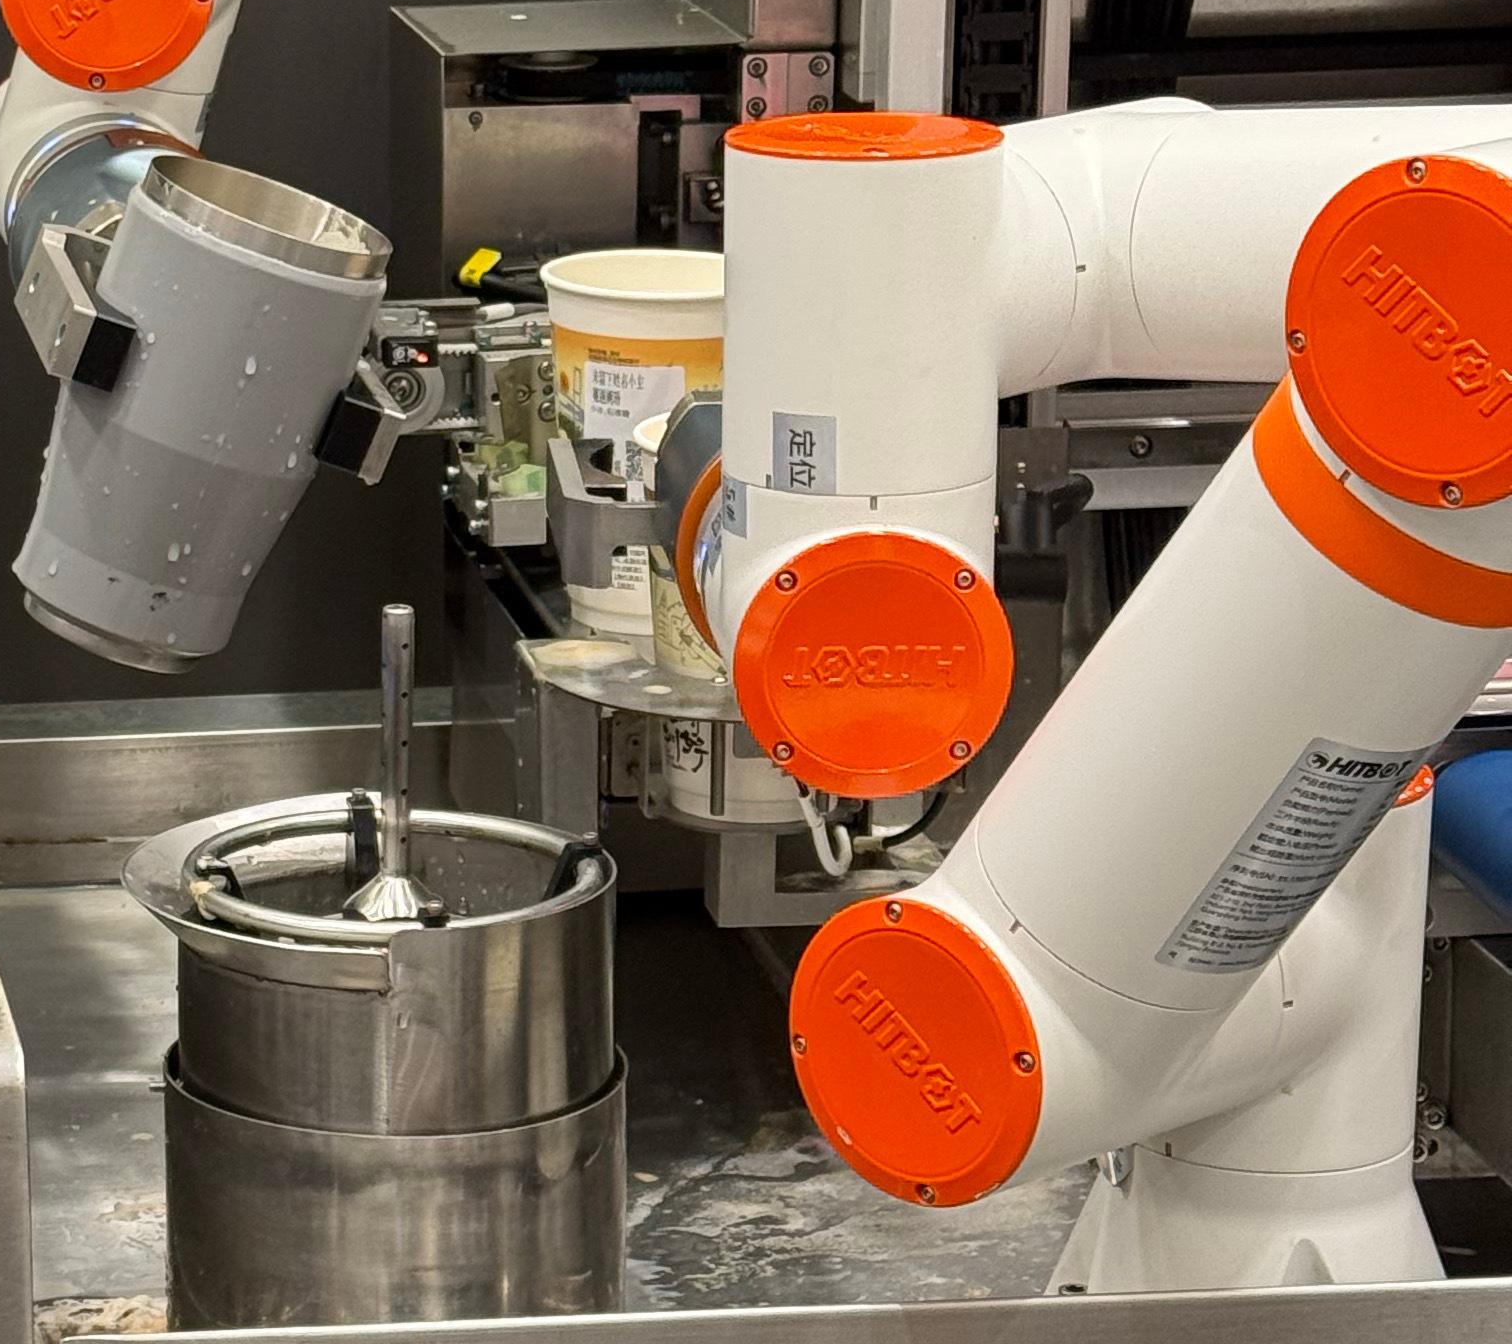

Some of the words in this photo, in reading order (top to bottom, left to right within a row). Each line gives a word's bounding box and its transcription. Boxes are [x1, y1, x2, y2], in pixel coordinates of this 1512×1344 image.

[1342, 244, 1512, 417] HITBOT
[788, 428, 817, 489] 定位
[782, 646, 967, 688] HITBOT
[1326, 756, 1413, 779] HITBOT
[834, 970, 983, 1134] HITBOT
